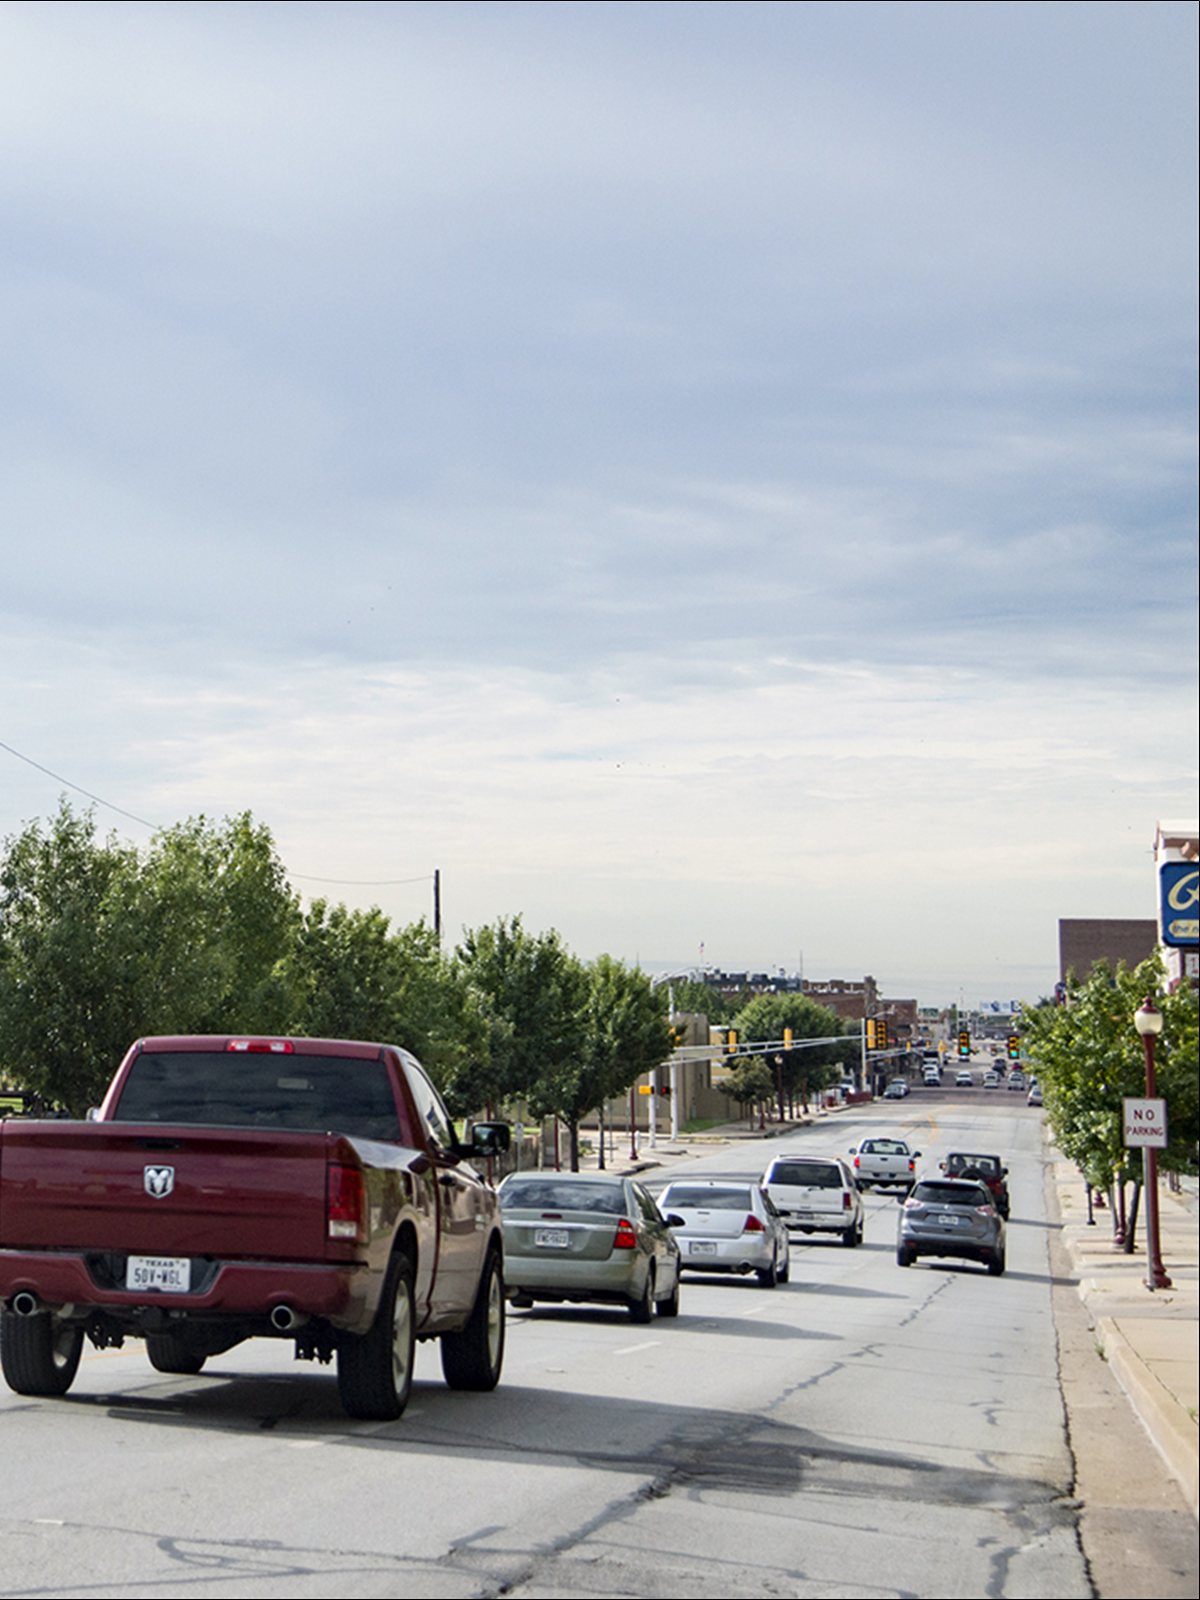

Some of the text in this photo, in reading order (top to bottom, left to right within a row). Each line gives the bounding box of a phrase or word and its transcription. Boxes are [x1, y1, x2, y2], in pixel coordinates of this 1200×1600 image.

[1133, 1108, 1155, 1121] NO
[1125, 1125, 1164, 1137] PARKING
[145, 1259, 175, 1268] TEXAS
